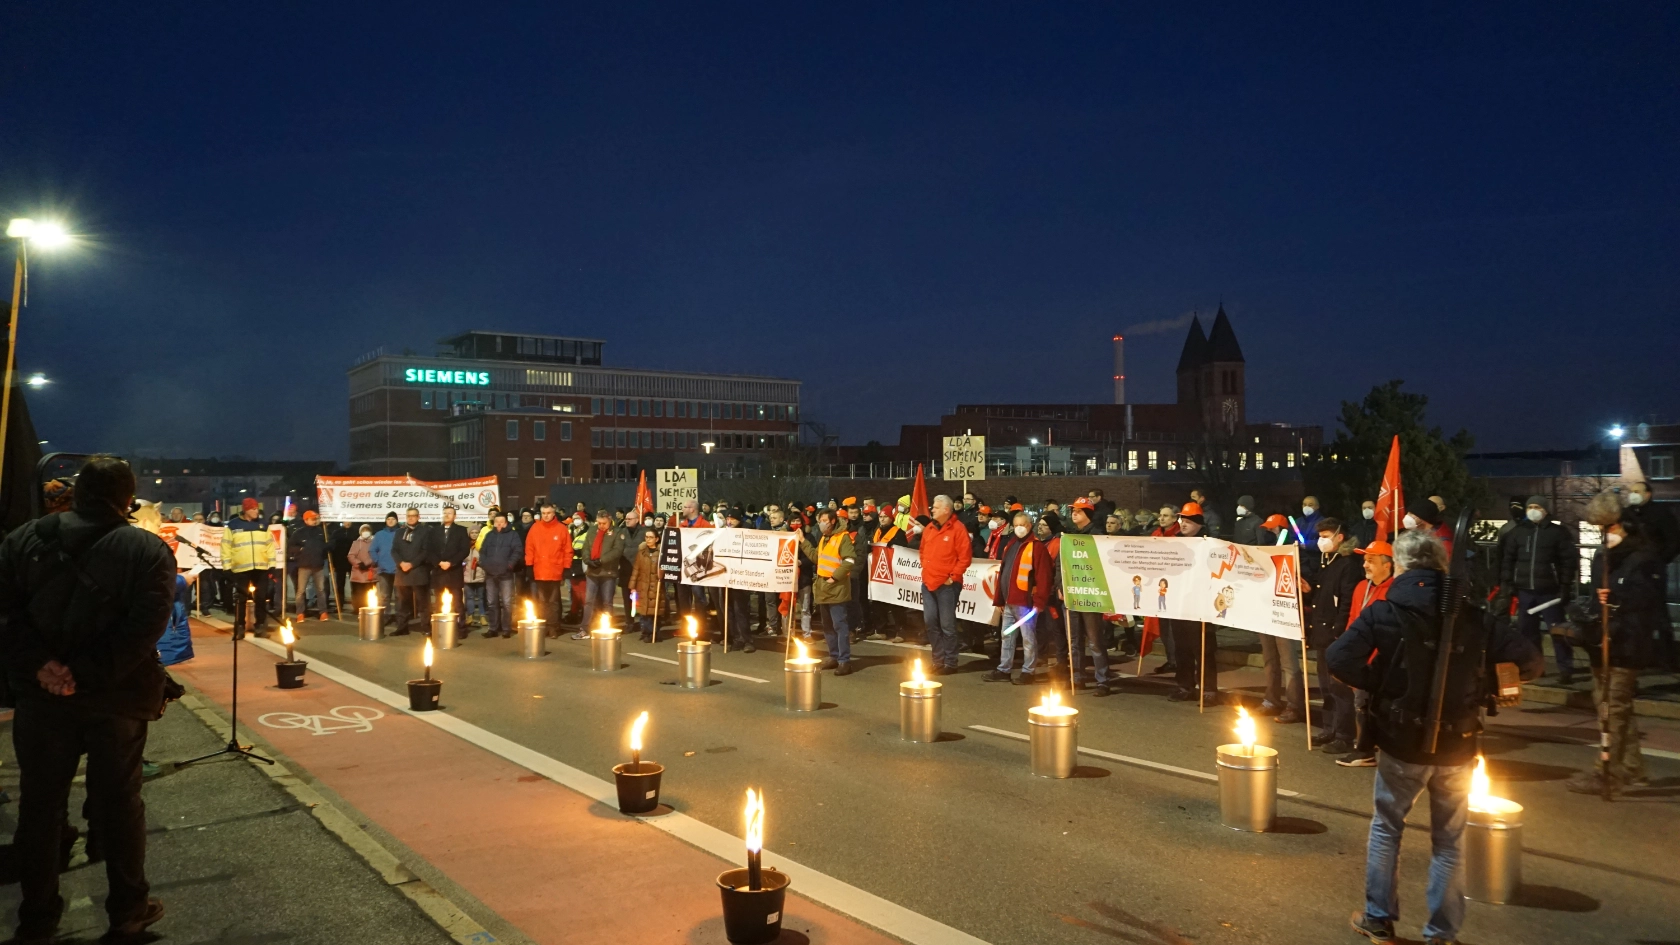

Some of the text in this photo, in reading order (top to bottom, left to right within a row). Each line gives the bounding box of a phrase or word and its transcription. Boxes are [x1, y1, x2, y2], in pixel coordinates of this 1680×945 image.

[405, 368, 490, 386] SIEMENS
[949, 437, 972, 448] LDA
[943, 450, 984, 463] SIEMENS
[664, 471, 687, 483] LDA
[949, 465, 975, 479] NBG
[340, 490, 371, 499] Gegen
[374, 490, 389, 498] die
[458, 492, 475, 500] des
[659, 487, 697, 499] SIEMENS
[341, 501, 383, 509] Siemens
[386, 501, 439, 509] Standortes
[666, 501, 683, 511] NBG
[897, 557, 911, 567] Nah
[745, 569, 765, 577] Standort
[1071, 574, 1079, 582] in
[749, 581, 769, 589] sterben!
[962, 583, 977, 591] etall
[1066, 586, 1100, 596] SIEMENS
[1072, 600, 1102, 608] bleiben
